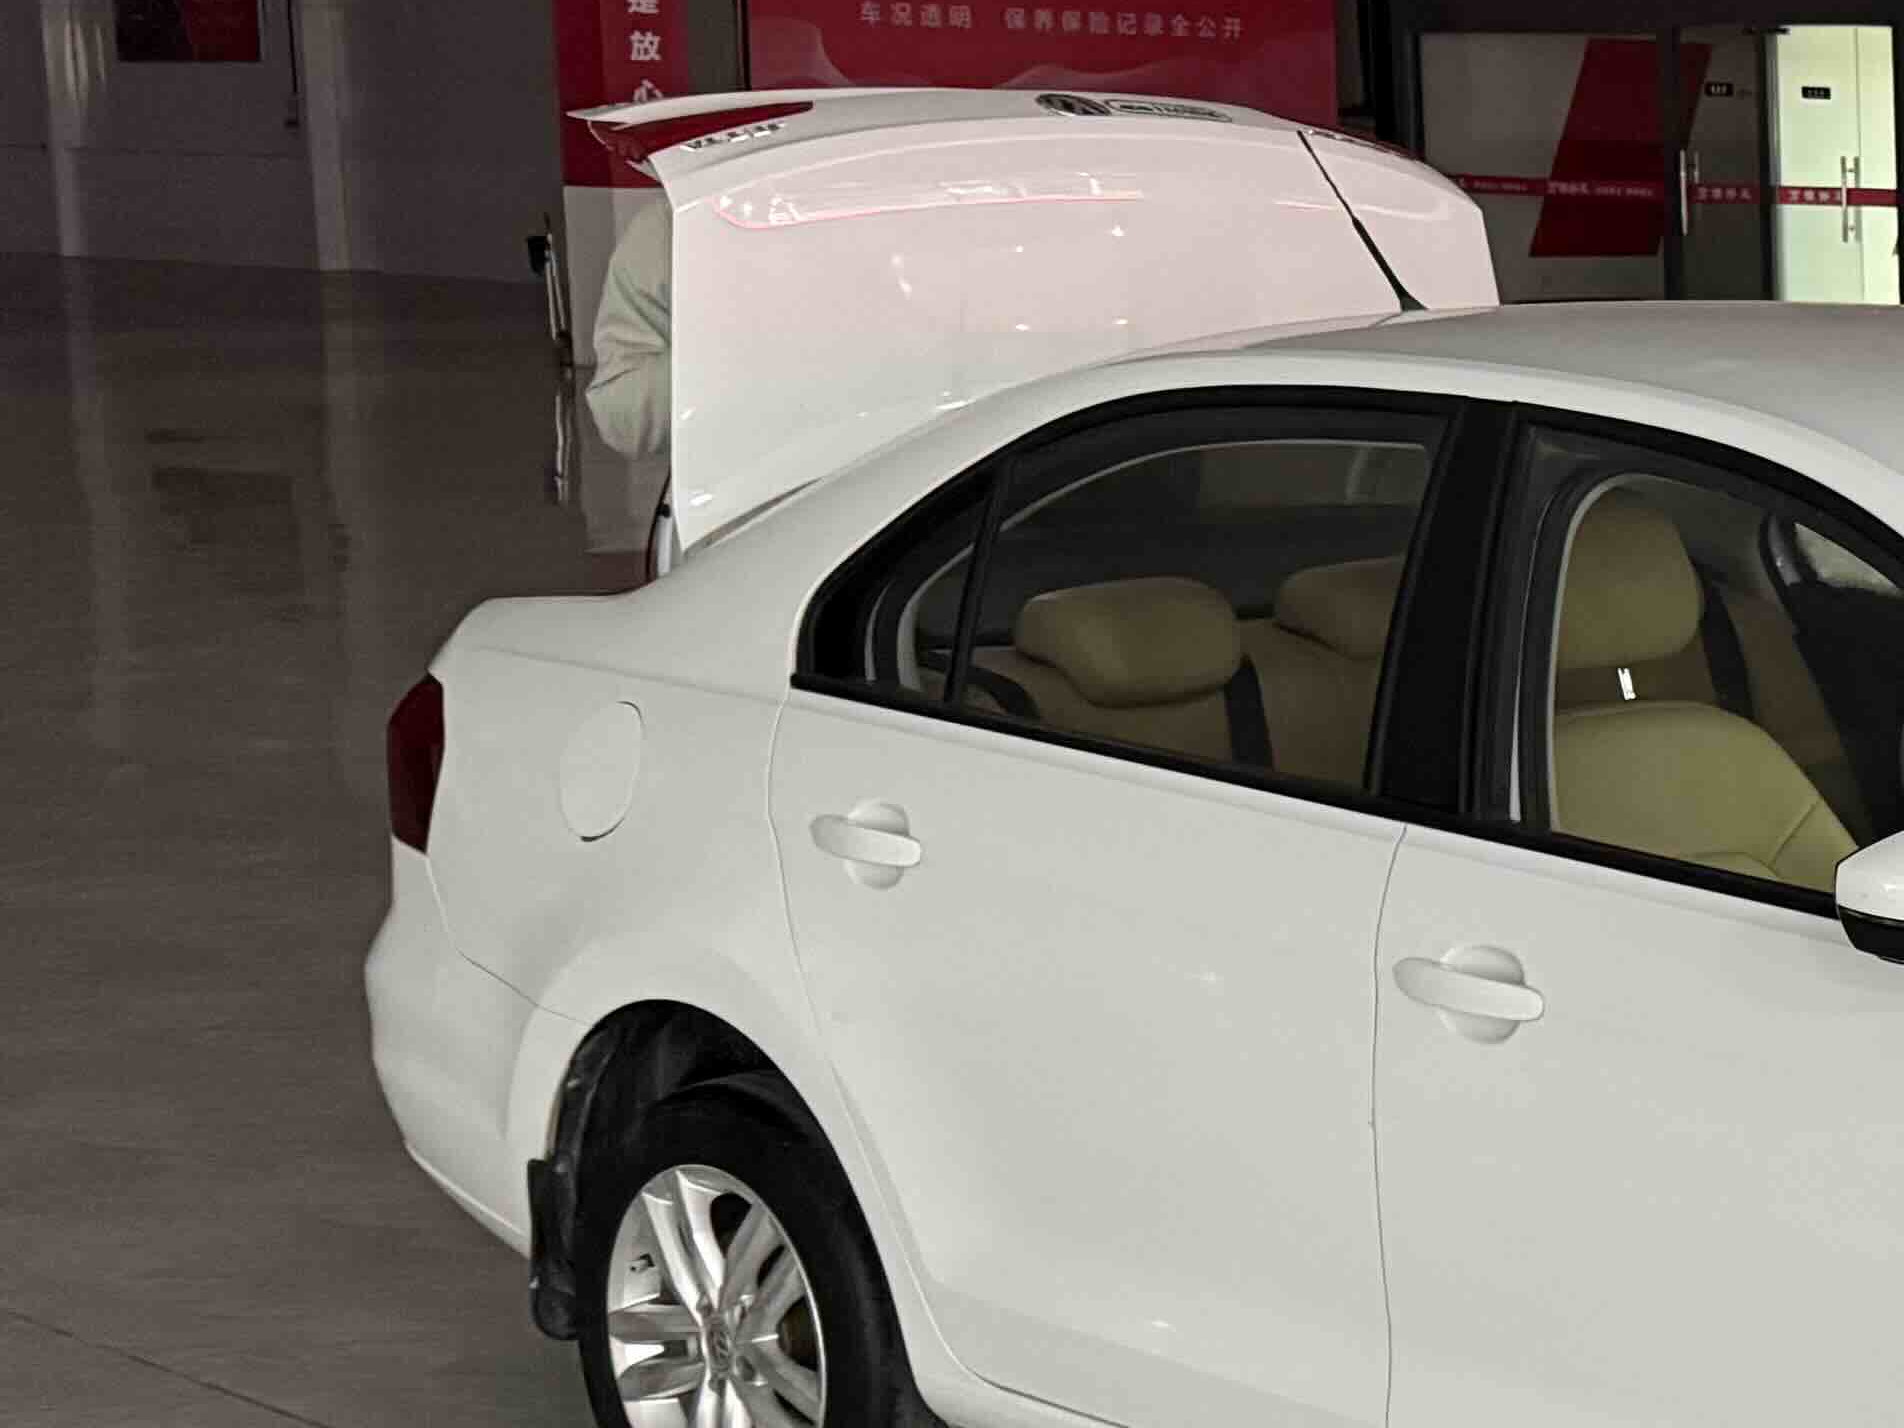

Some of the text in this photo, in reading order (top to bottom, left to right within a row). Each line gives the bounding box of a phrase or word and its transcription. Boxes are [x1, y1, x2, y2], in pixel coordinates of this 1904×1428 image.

[859, 1, 1244, 39] 车况透明 保养保险记录全公开
